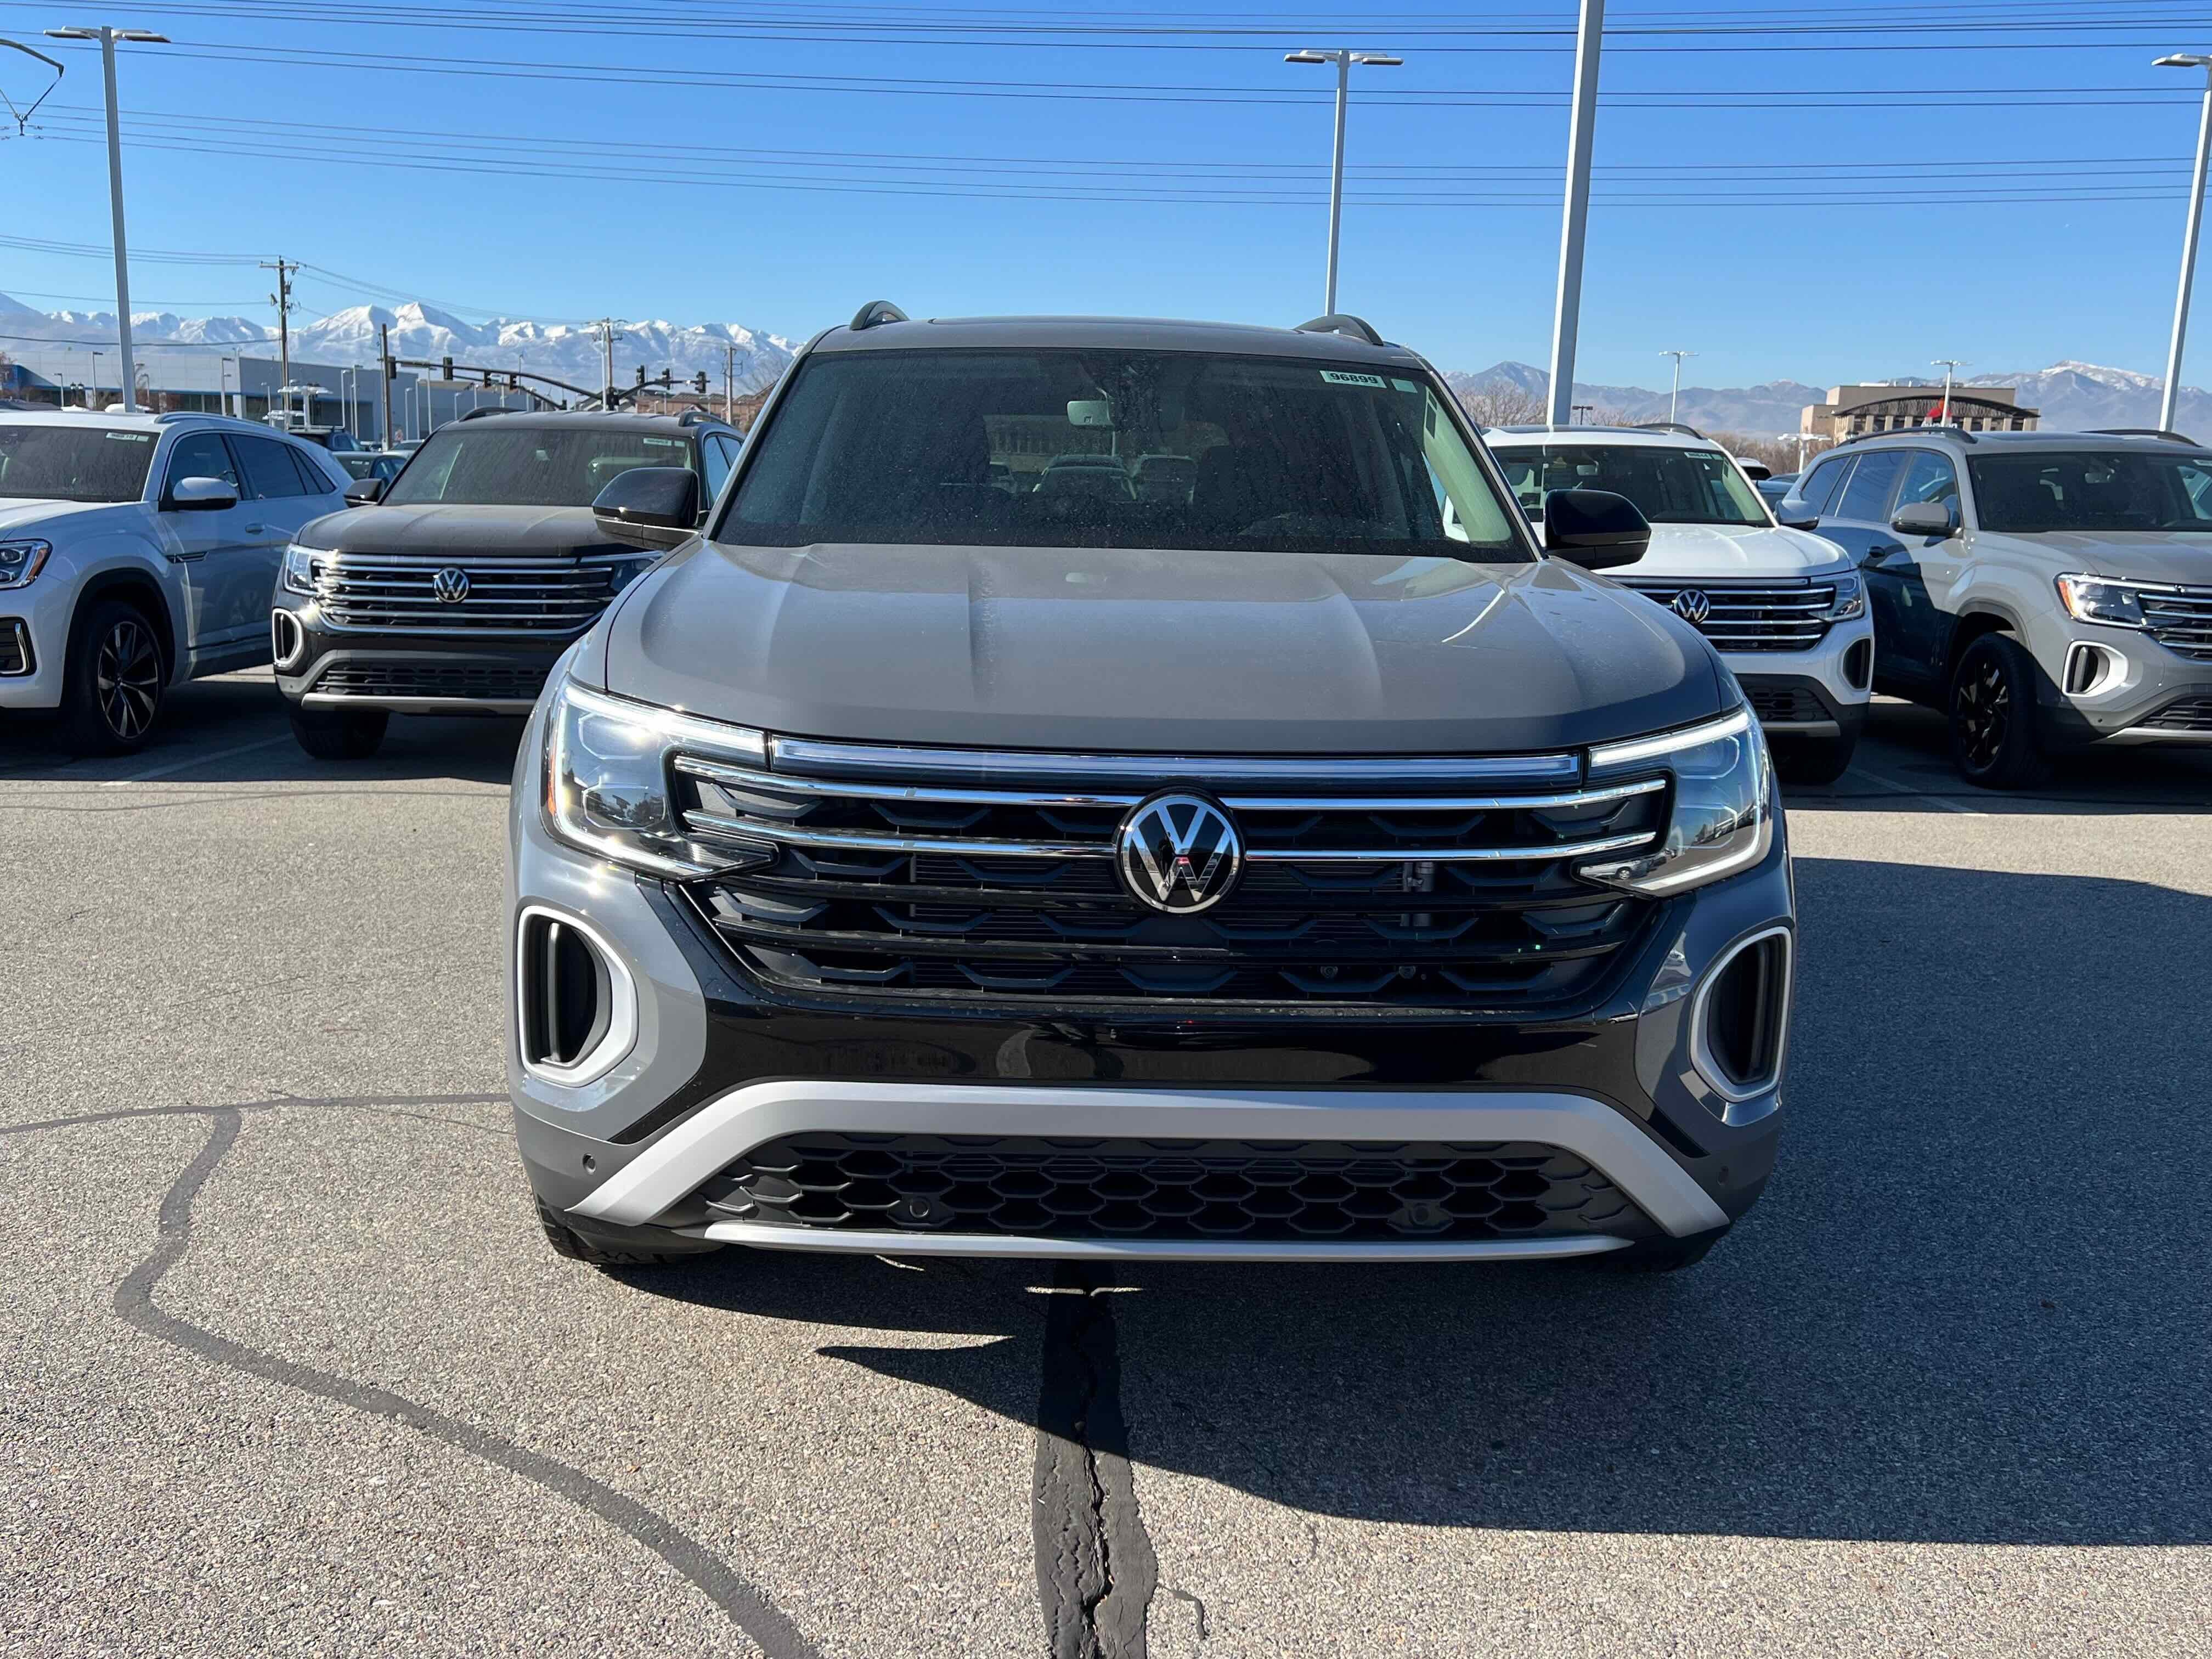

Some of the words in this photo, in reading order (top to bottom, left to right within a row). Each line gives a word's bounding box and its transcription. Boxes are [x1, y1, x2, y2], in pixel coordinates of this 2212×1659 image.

[1330, 373, 1379, 383] 96899
[436, 568, 467, 601] VW
[1675, 590, 1708, 621] VW
[1127, 799, 1235, 906] VW
